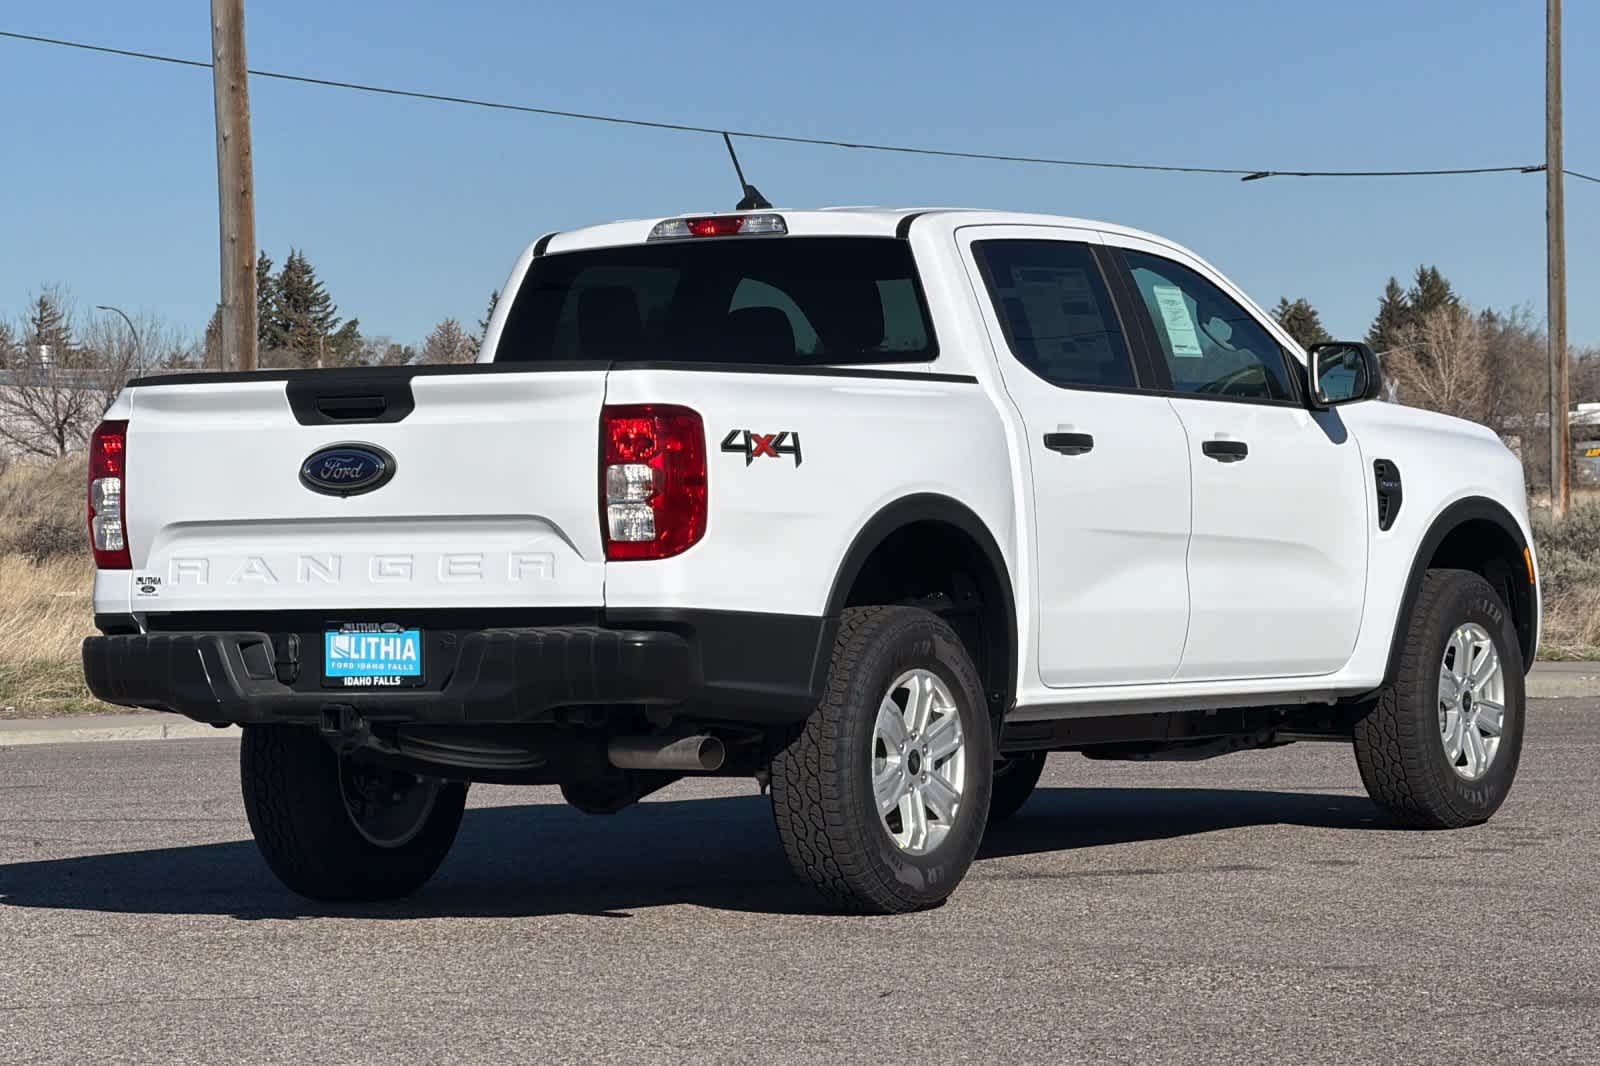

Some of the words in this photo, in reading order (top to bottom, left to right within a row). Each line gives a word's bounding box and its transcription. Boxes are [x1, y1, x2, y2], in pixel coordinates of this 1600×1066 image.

[320, 456, 365, 479] Ford
[168, 552, 558, 584] RANGER
[350, 636, 416, 661] LITHIA
[331, 661, 354, 670] FORD
[357, 662, 385, 670] IDAHO
[387, 663, 414, 671] FALLS
[343, 676, 372, 686] IDAHO
[373, 676, 401, 686] FALLS
